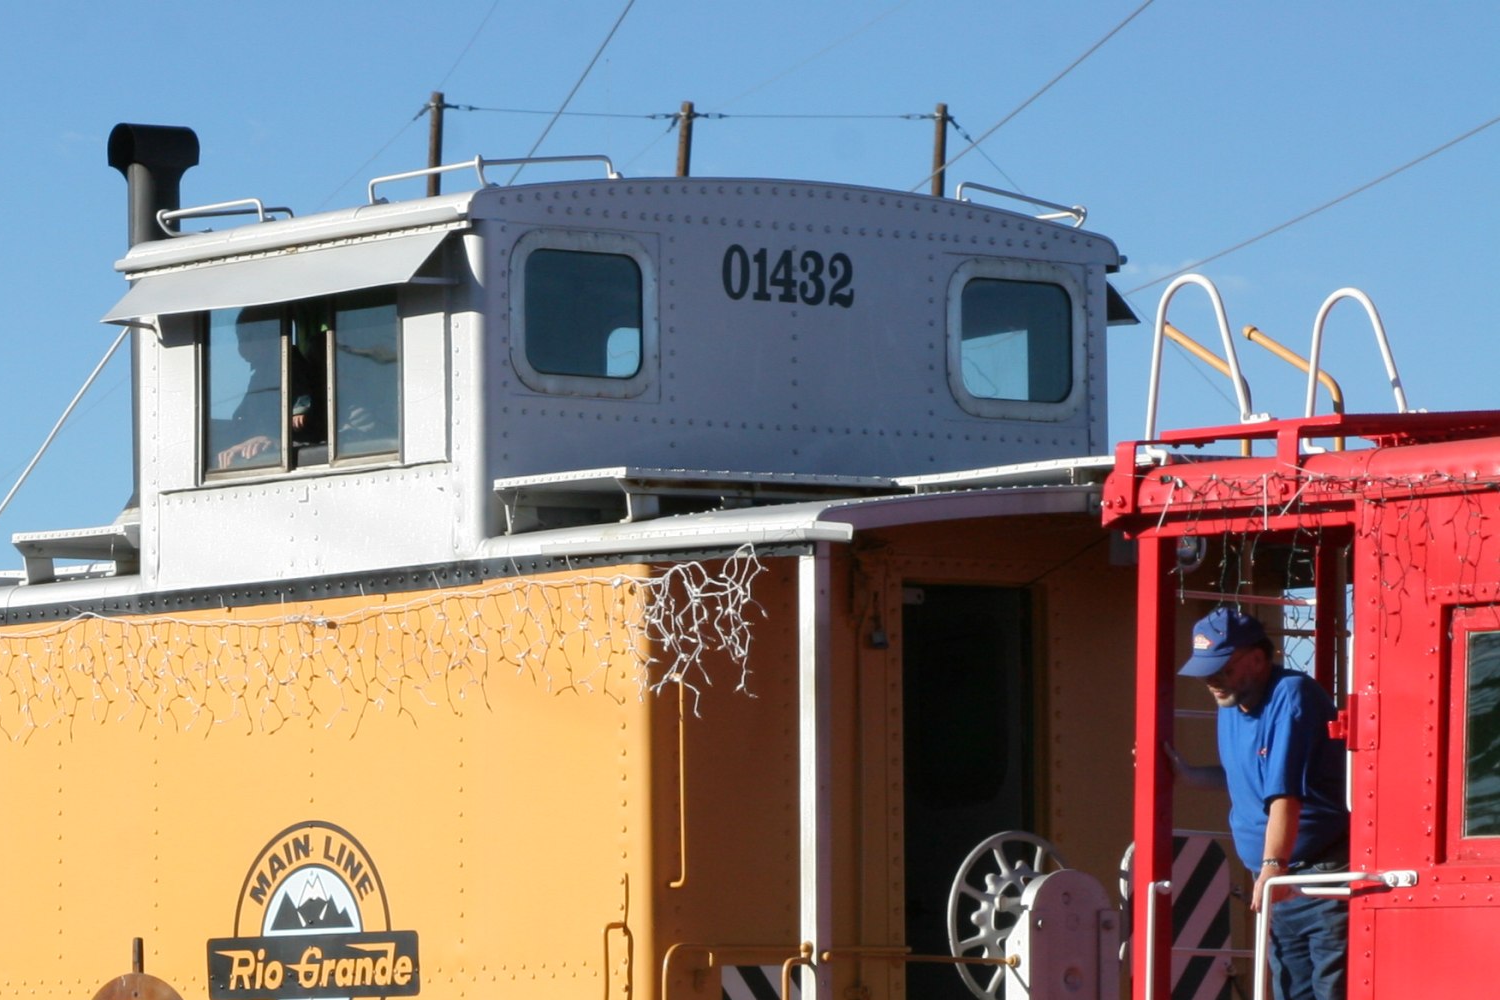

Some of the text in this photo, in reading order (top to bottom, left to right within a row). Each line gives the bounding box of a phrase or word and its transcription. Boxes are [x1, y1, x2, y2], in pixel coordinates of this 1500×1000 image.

[722, 243, 854, 309] 01432
[249, 833, 375, 907] MAIN LINE
[214, 941, 413, 990] Rio Grande
